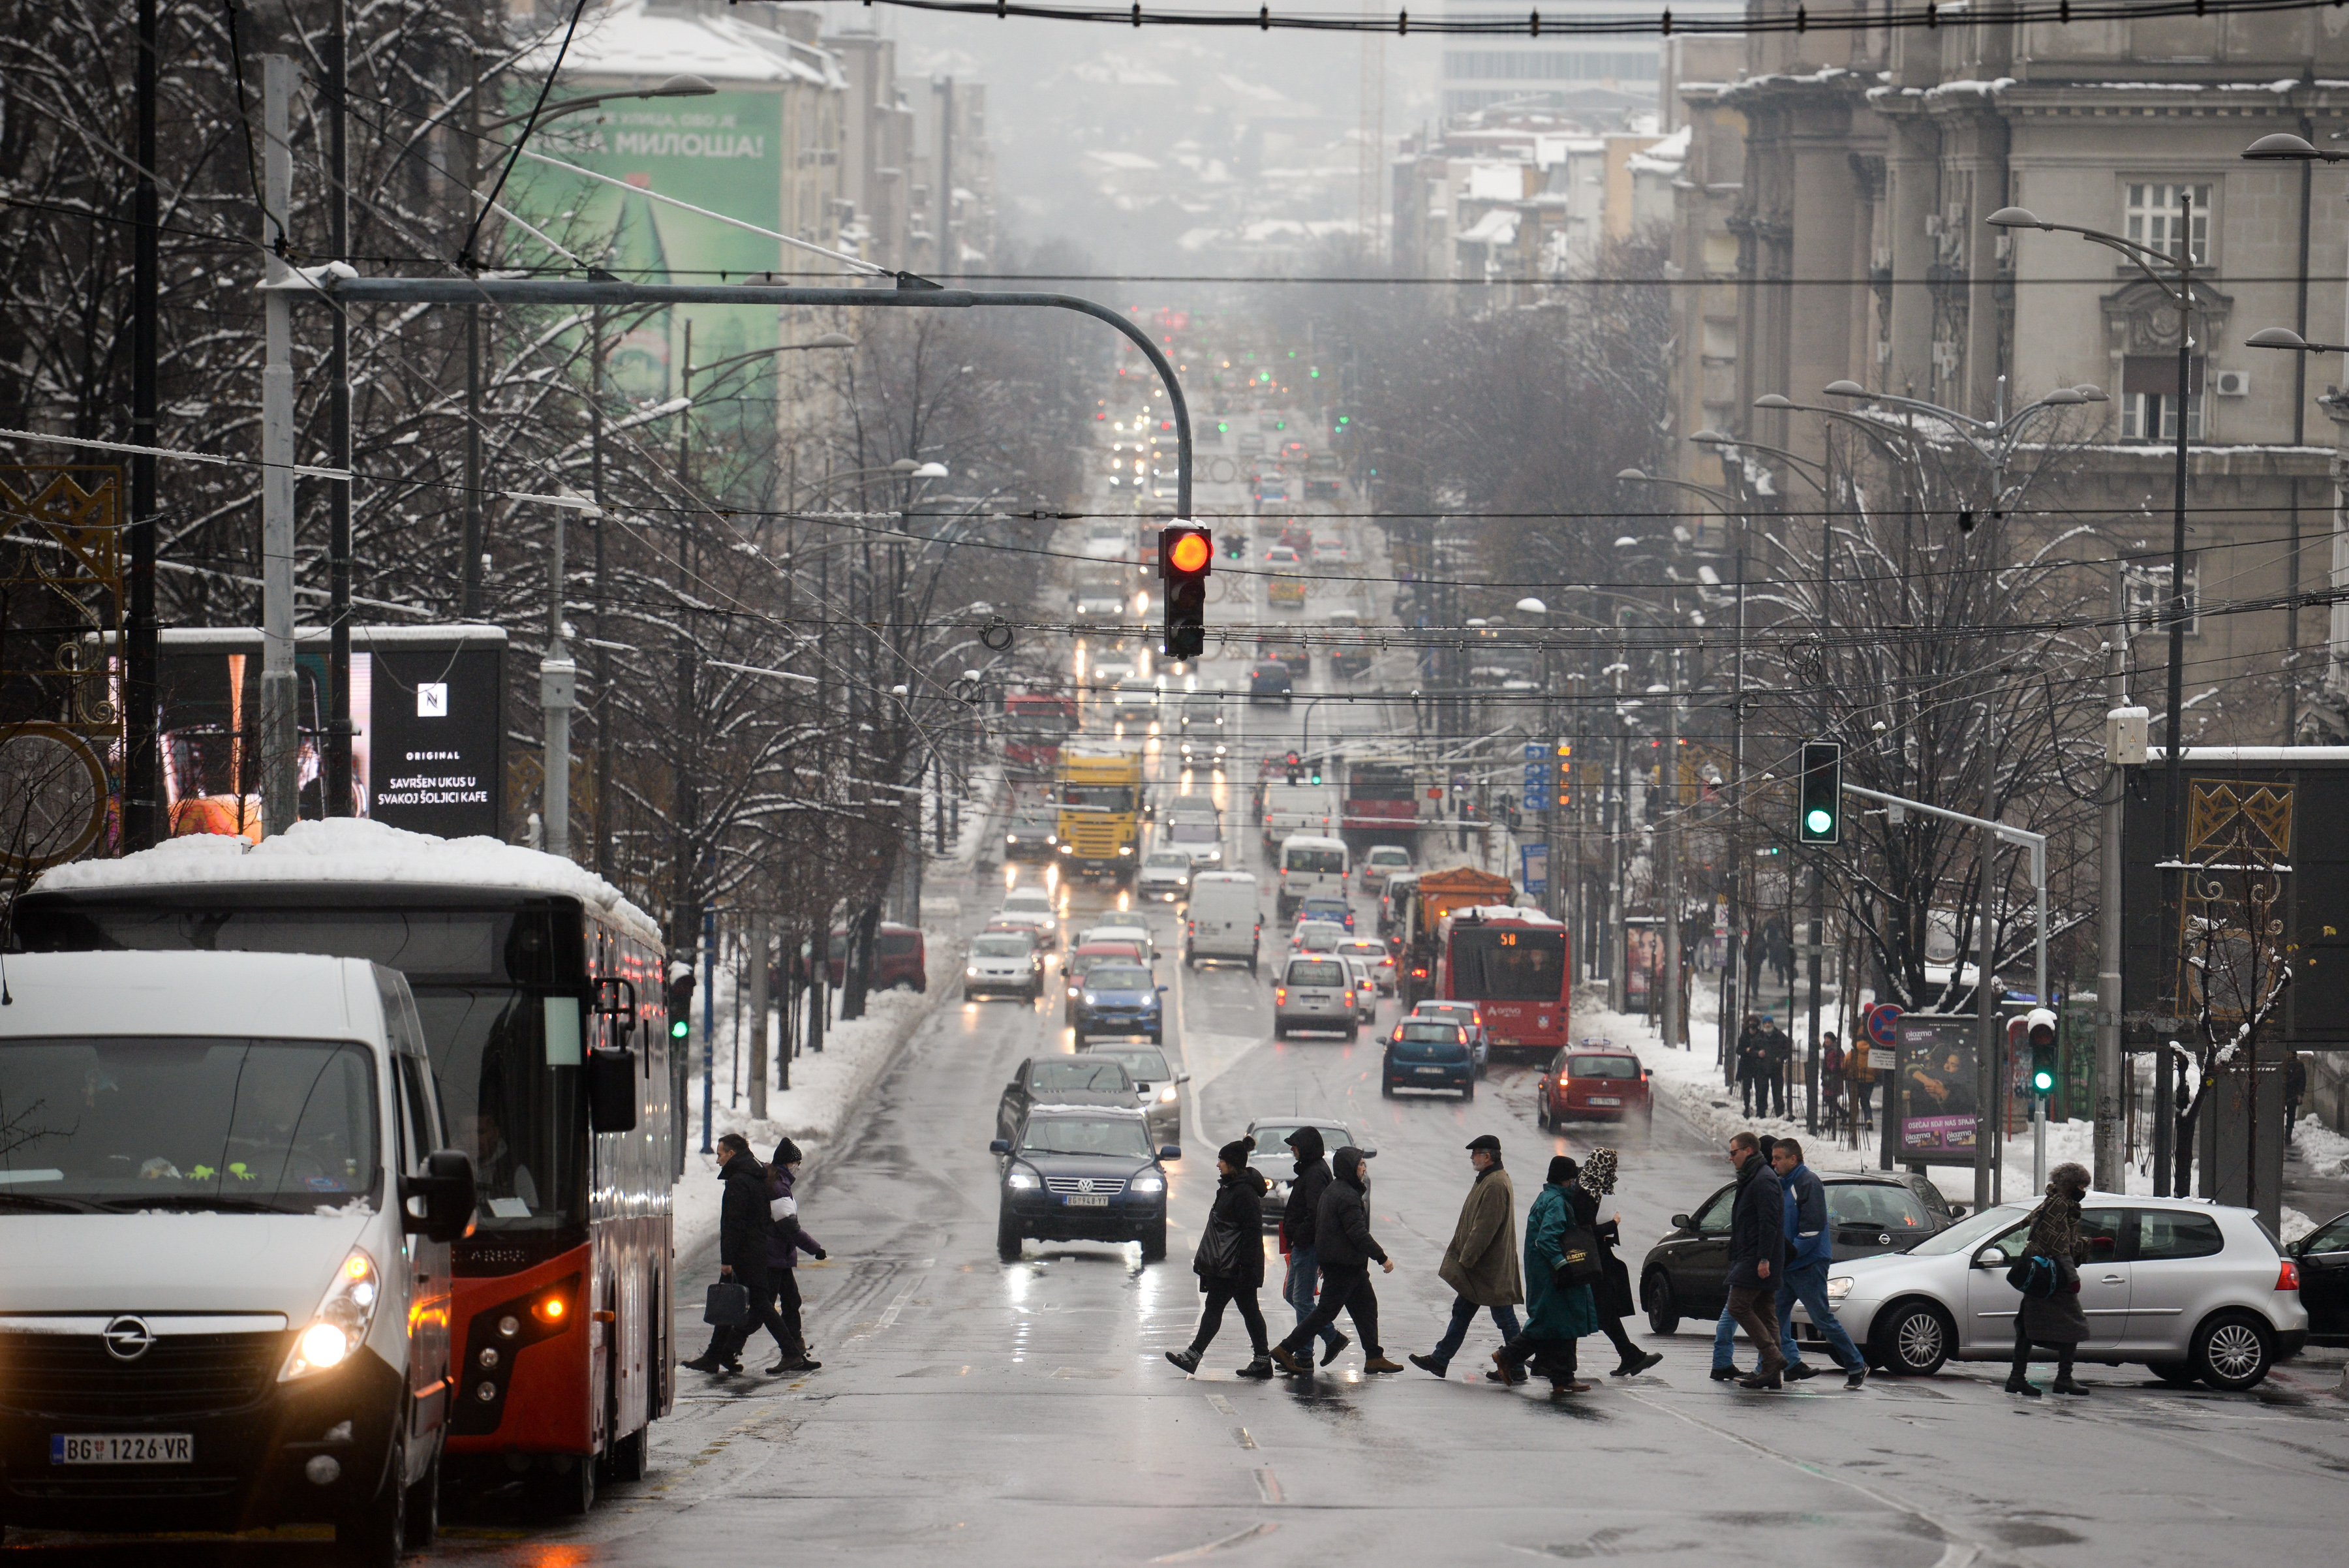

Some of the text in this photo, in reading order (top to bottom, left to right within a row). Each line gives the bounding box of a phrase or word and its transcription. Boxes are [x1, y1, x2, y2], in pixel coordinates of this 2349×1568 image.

[679, 114, 716, 127] ОВО
[615, 132, 765, 158] МИЛОША!
[405, 751, 461, 761] ORIGINAL
[390, 774, 476, 790] SAVRŠEN UKUS U
[378, 789, 488, 805] SVAKOJ ŠOLJICI KAFE
[1500, 932, 1516, 946] 58
[1905, 1030, 1933, 1039] plazma
[1905, 1131, 1931, 1143] plazma
[1946, 1130, 1972, 1141] plazma
[68, 1439, 92, 1460] BG
